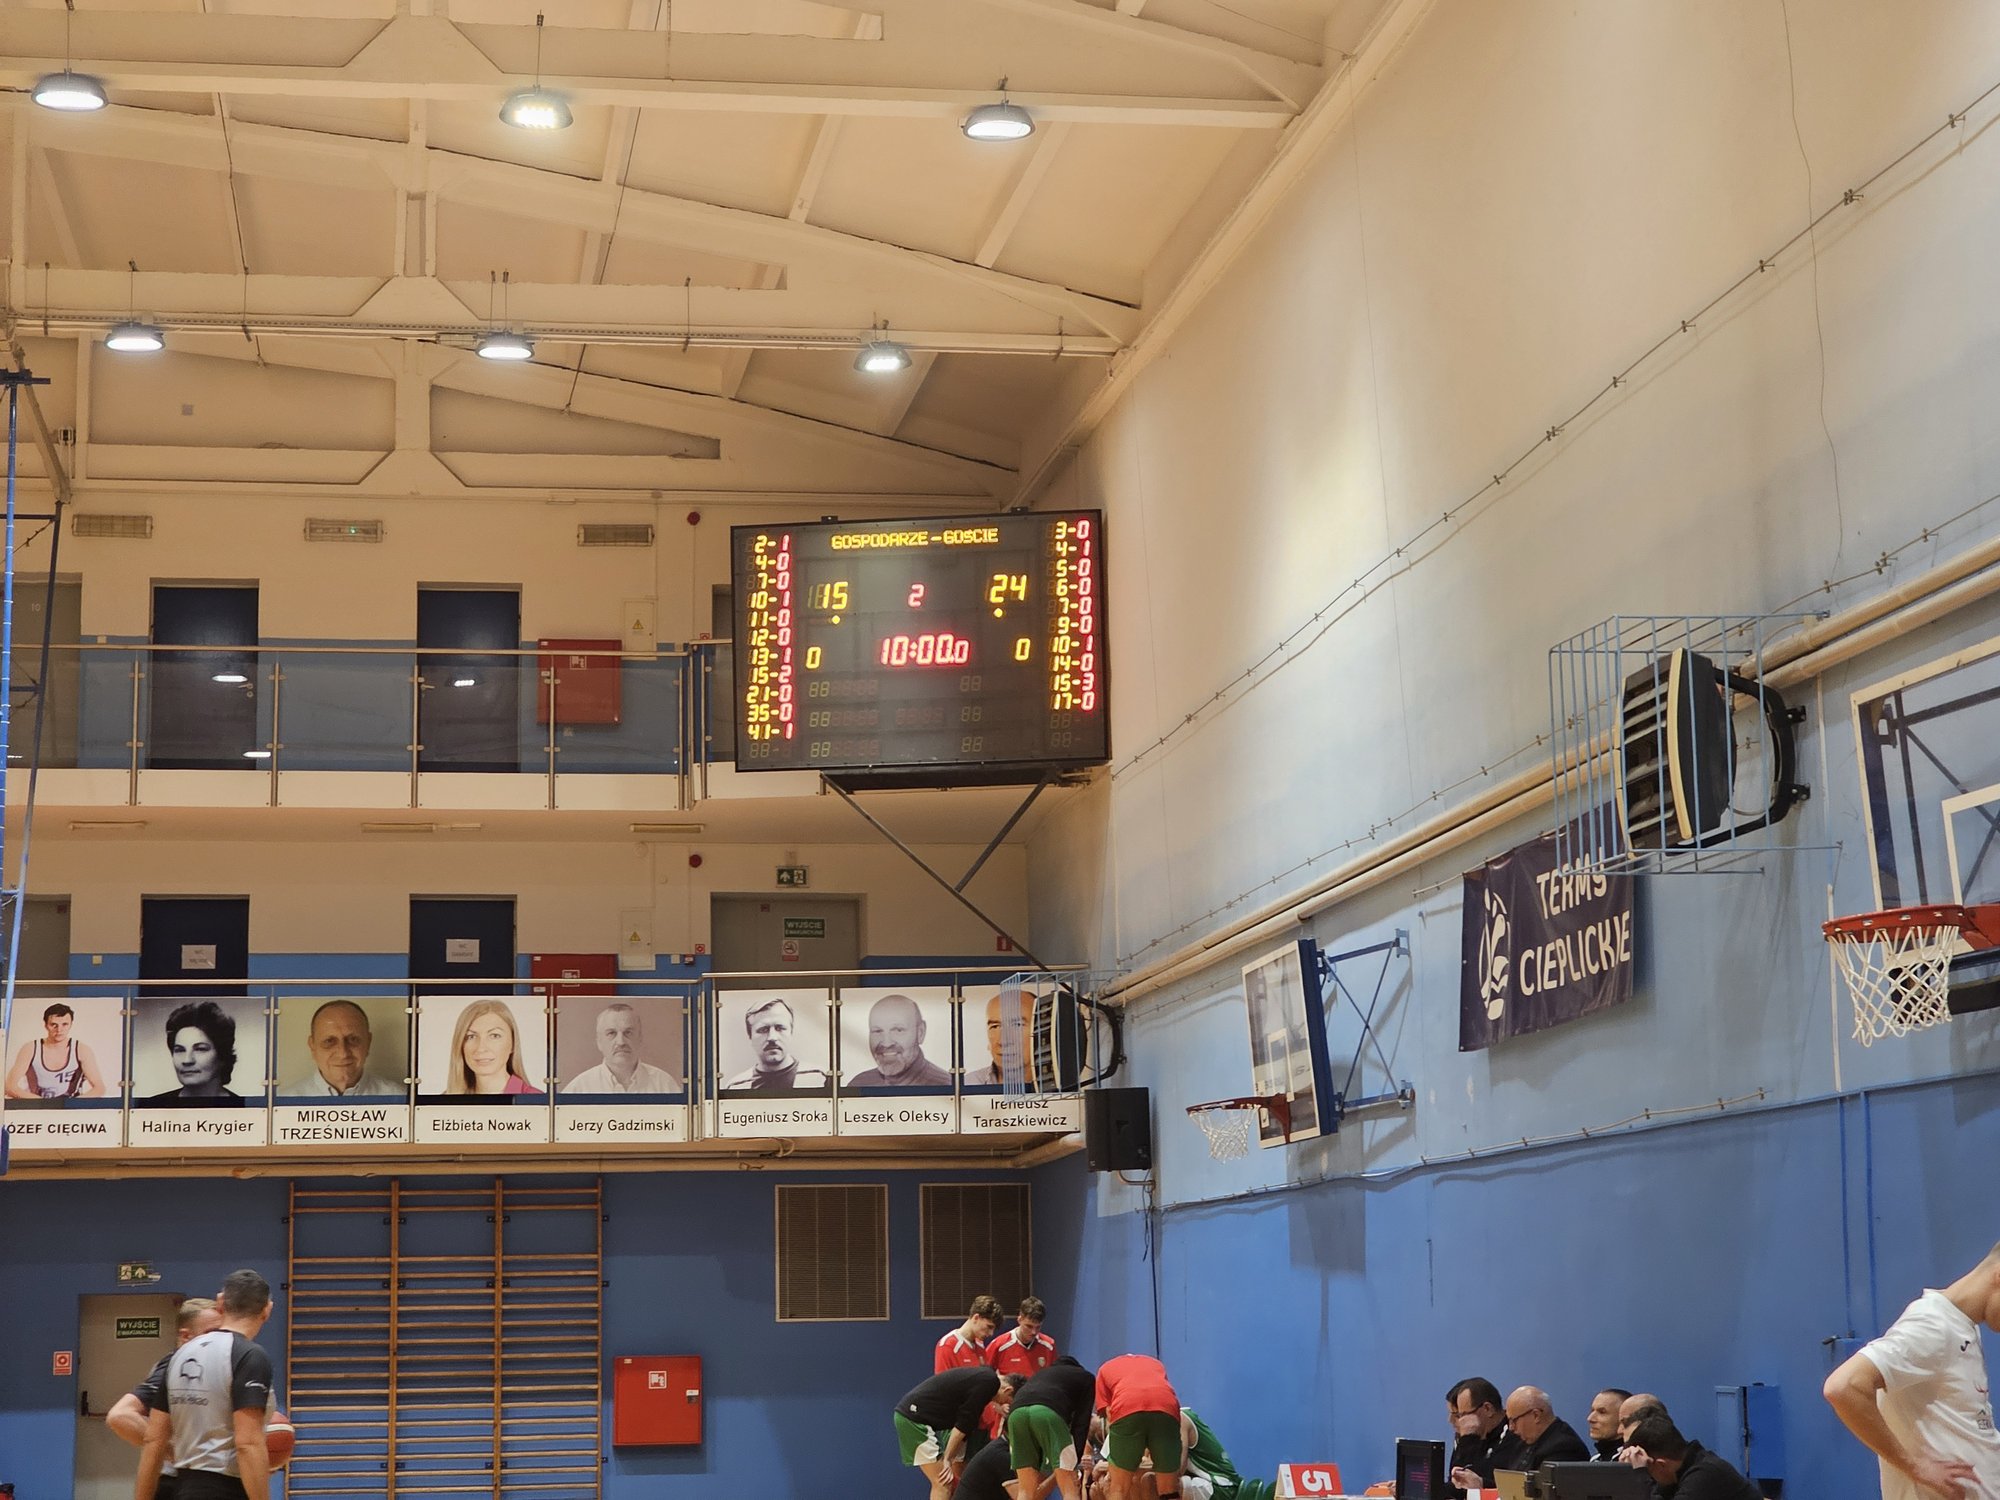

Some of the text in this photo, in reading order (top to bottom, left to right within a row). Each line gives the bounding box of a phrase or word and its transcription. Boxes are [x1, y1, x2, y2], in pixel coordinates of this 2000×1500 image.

[908, 583, 925, 608] 2
[989, 574, 1027, 604] 24
[805, 646, 822, 669] 0
[1015, 638, 1031, 662] 0
[1536, 847, 1607, 920] TERMY
[1519, 910, 1631, 997] CIEPLICKIE
[297, 1109, 387, 1123] MIROSŁAW
[723, 1110, 828, 1126] Eugeniusz Sroka
[844, 1109, 950, 1125] Leszek Oleksy
[973, 1112, 1067, 1128] Taraszkiewicz
[7, 1121, 107, 1136] ÓZEF CIĘCIWA
[142, 1120, 254, 1136] Halina Krygier
[281, 1124, 404, 1141] TRZEŚNIEWSKI
[432, 1118, 532, 1132] Elżbieta Nowak
[568, 1118, 675, 1134] Jerzy Gadzimski
[119, 1320, 157, 1329] WYJŚCIE
[1301, 1469, 1334, 1492] 5
